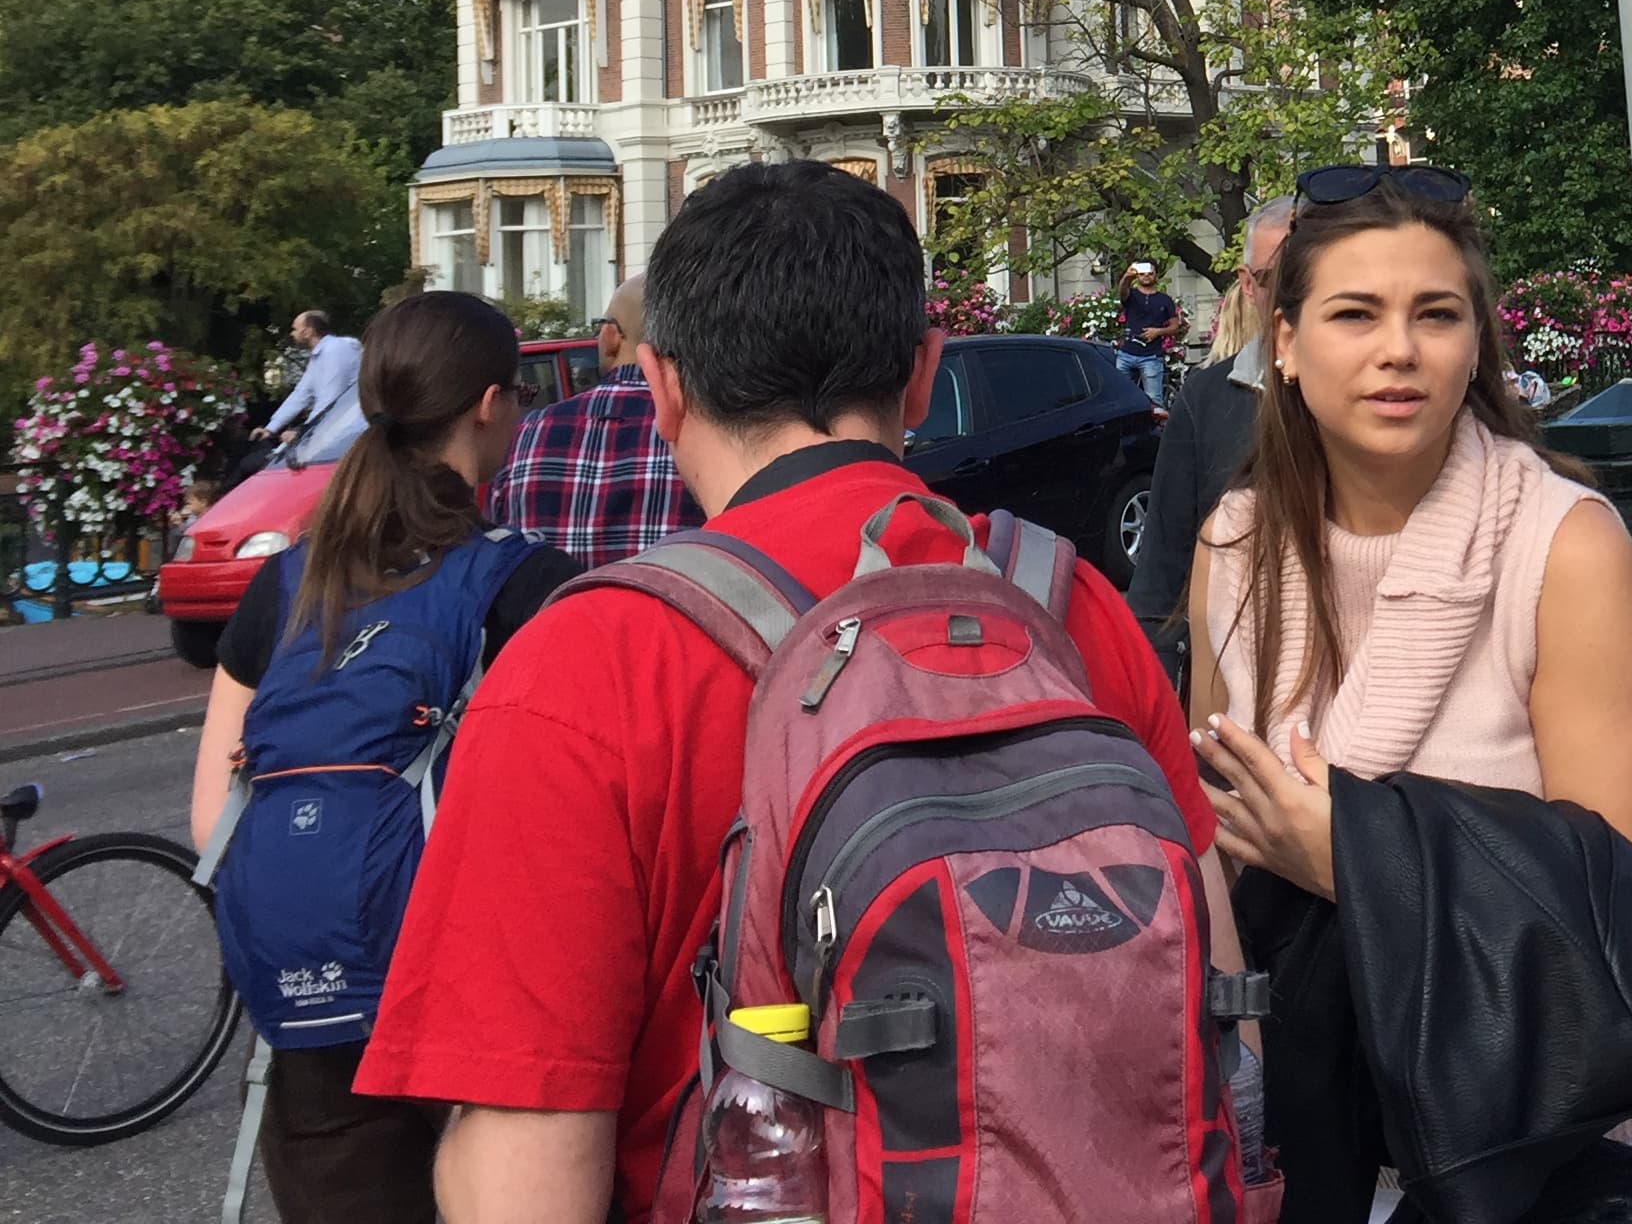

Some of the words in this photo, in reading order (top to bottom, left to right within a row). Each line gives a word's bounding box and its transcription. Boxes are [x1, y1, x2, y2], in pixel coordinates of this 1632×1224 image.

[1045, 912, 1114, 928] VAUDE
[277, 967, 315, 984] Jack
[278, 979, 348, 997] Wolfskin
